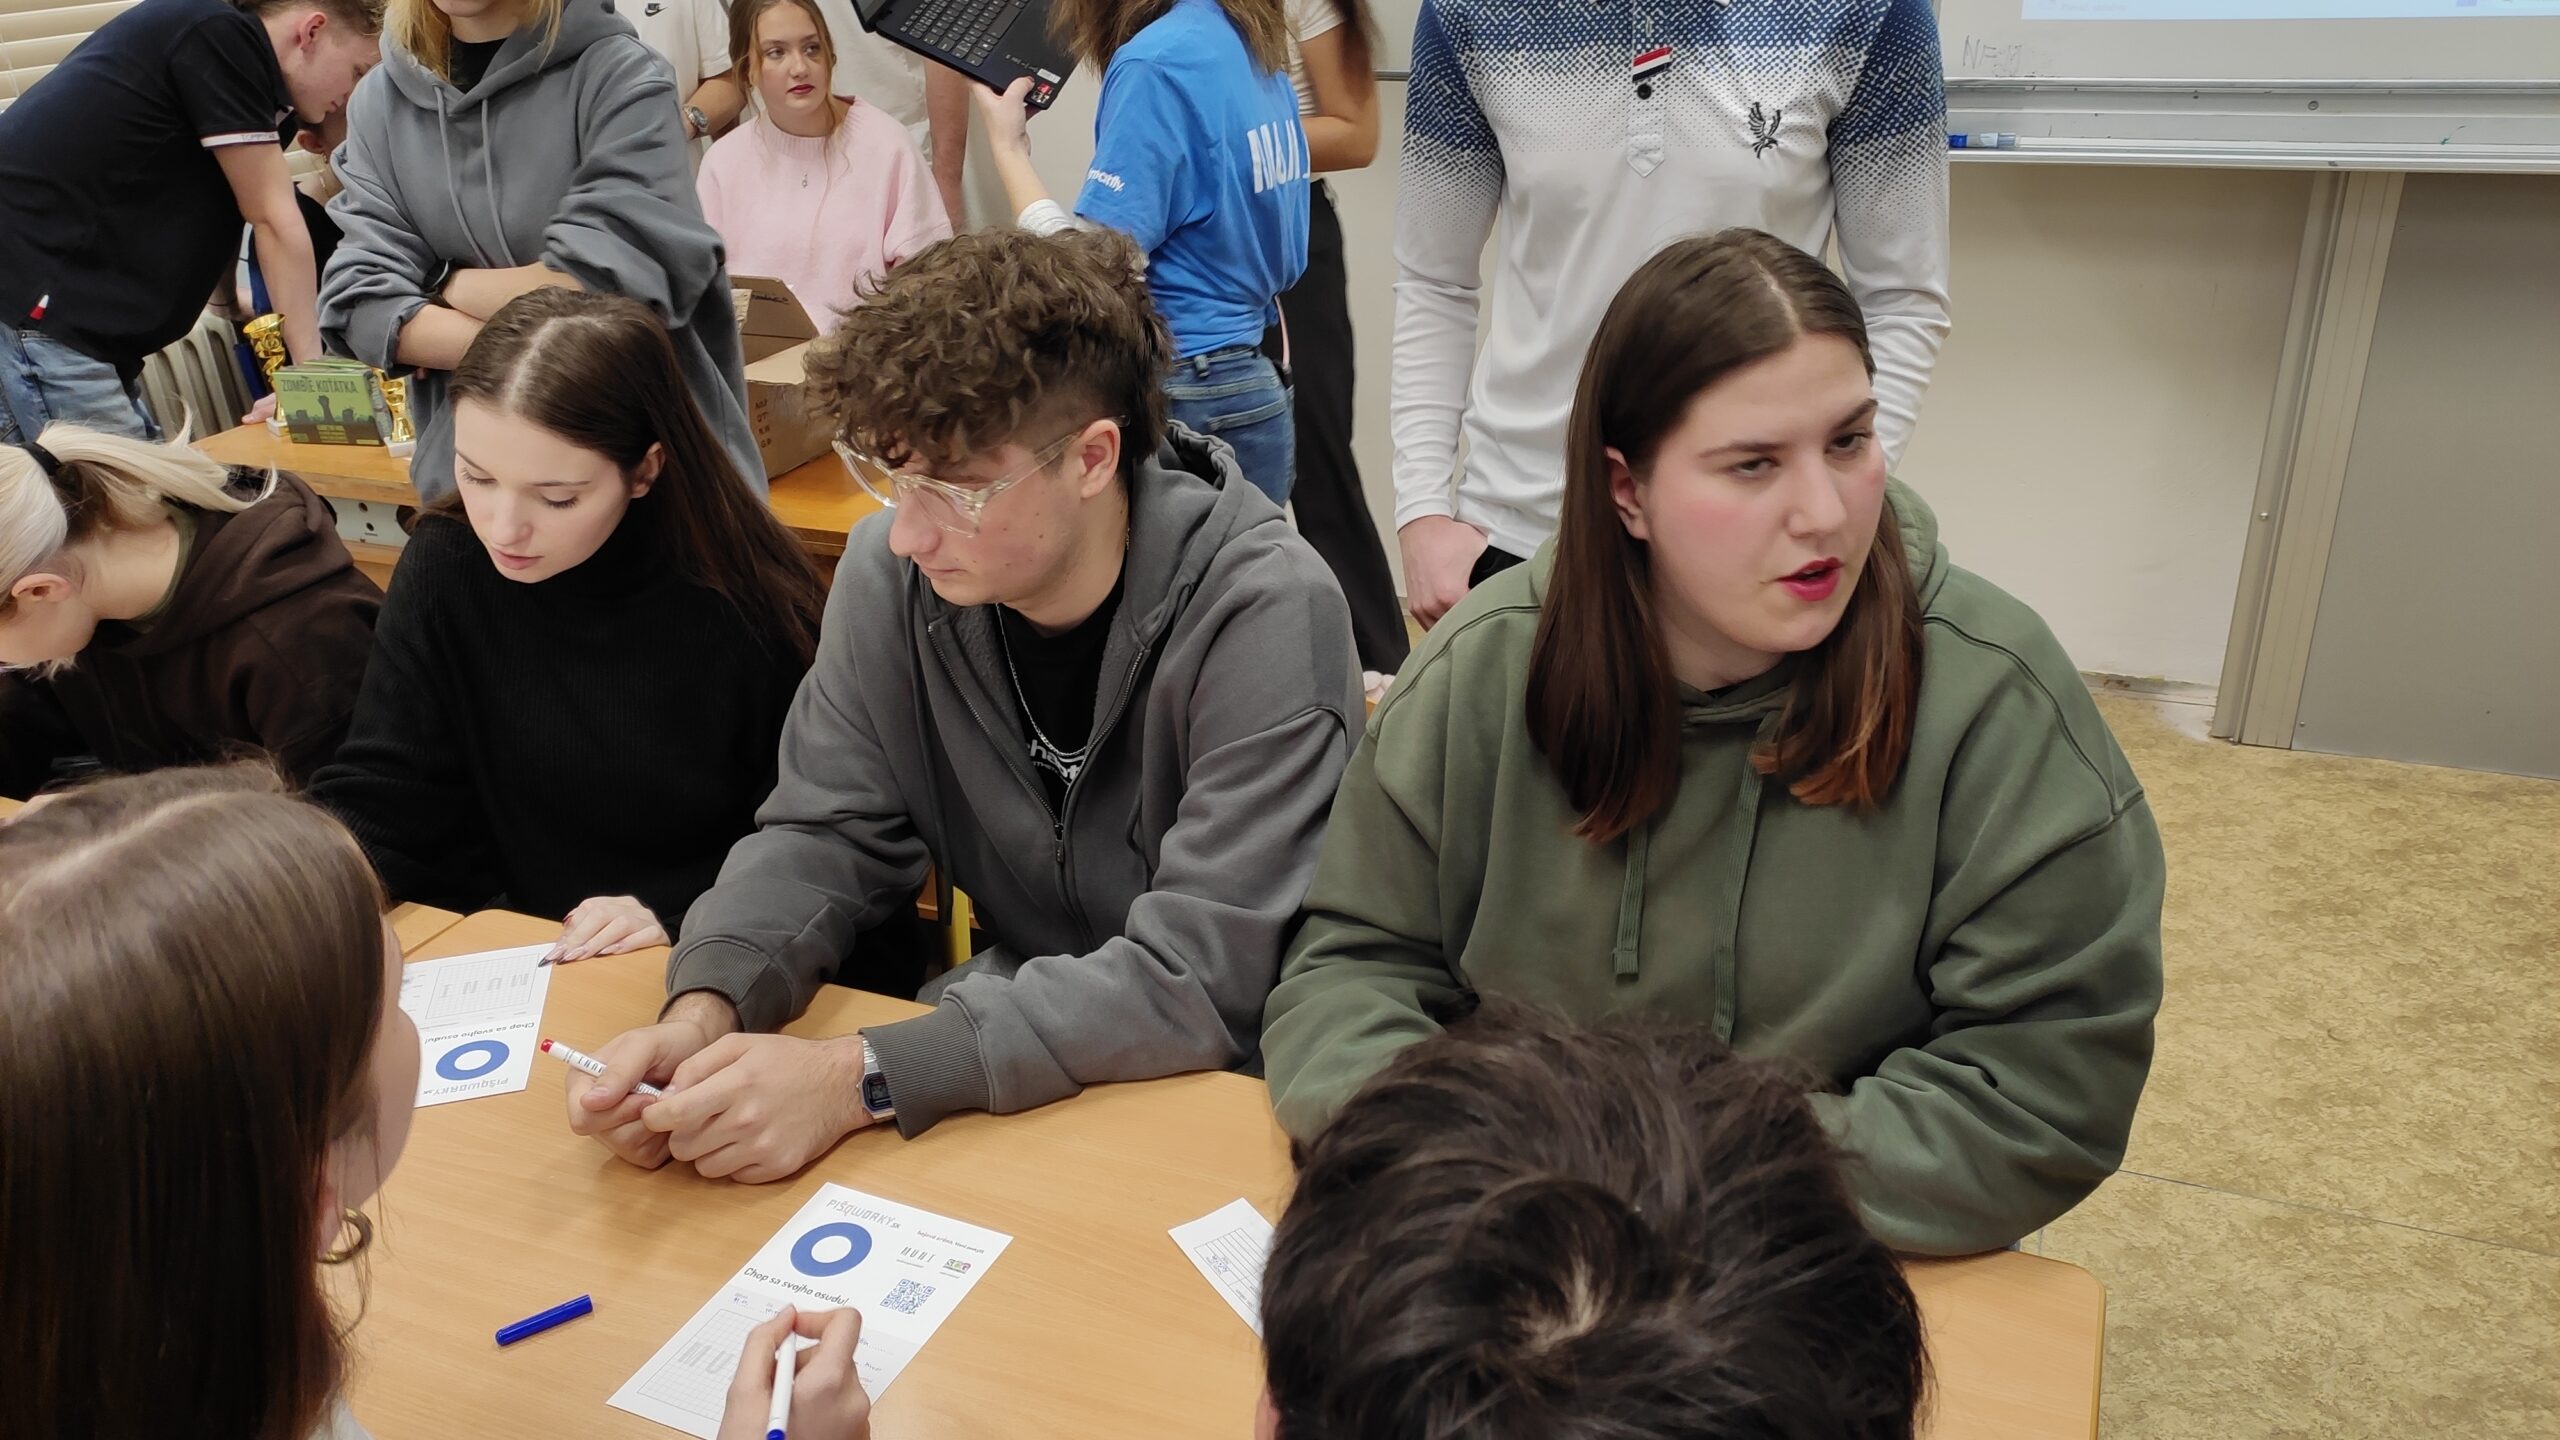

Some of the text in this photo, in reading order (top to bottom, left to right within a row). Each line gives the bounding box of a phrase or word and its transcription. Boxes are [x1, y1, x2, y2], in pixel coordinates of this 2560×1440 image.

[744, 1267, 850, 1306] Chop sa svojho osudu!
